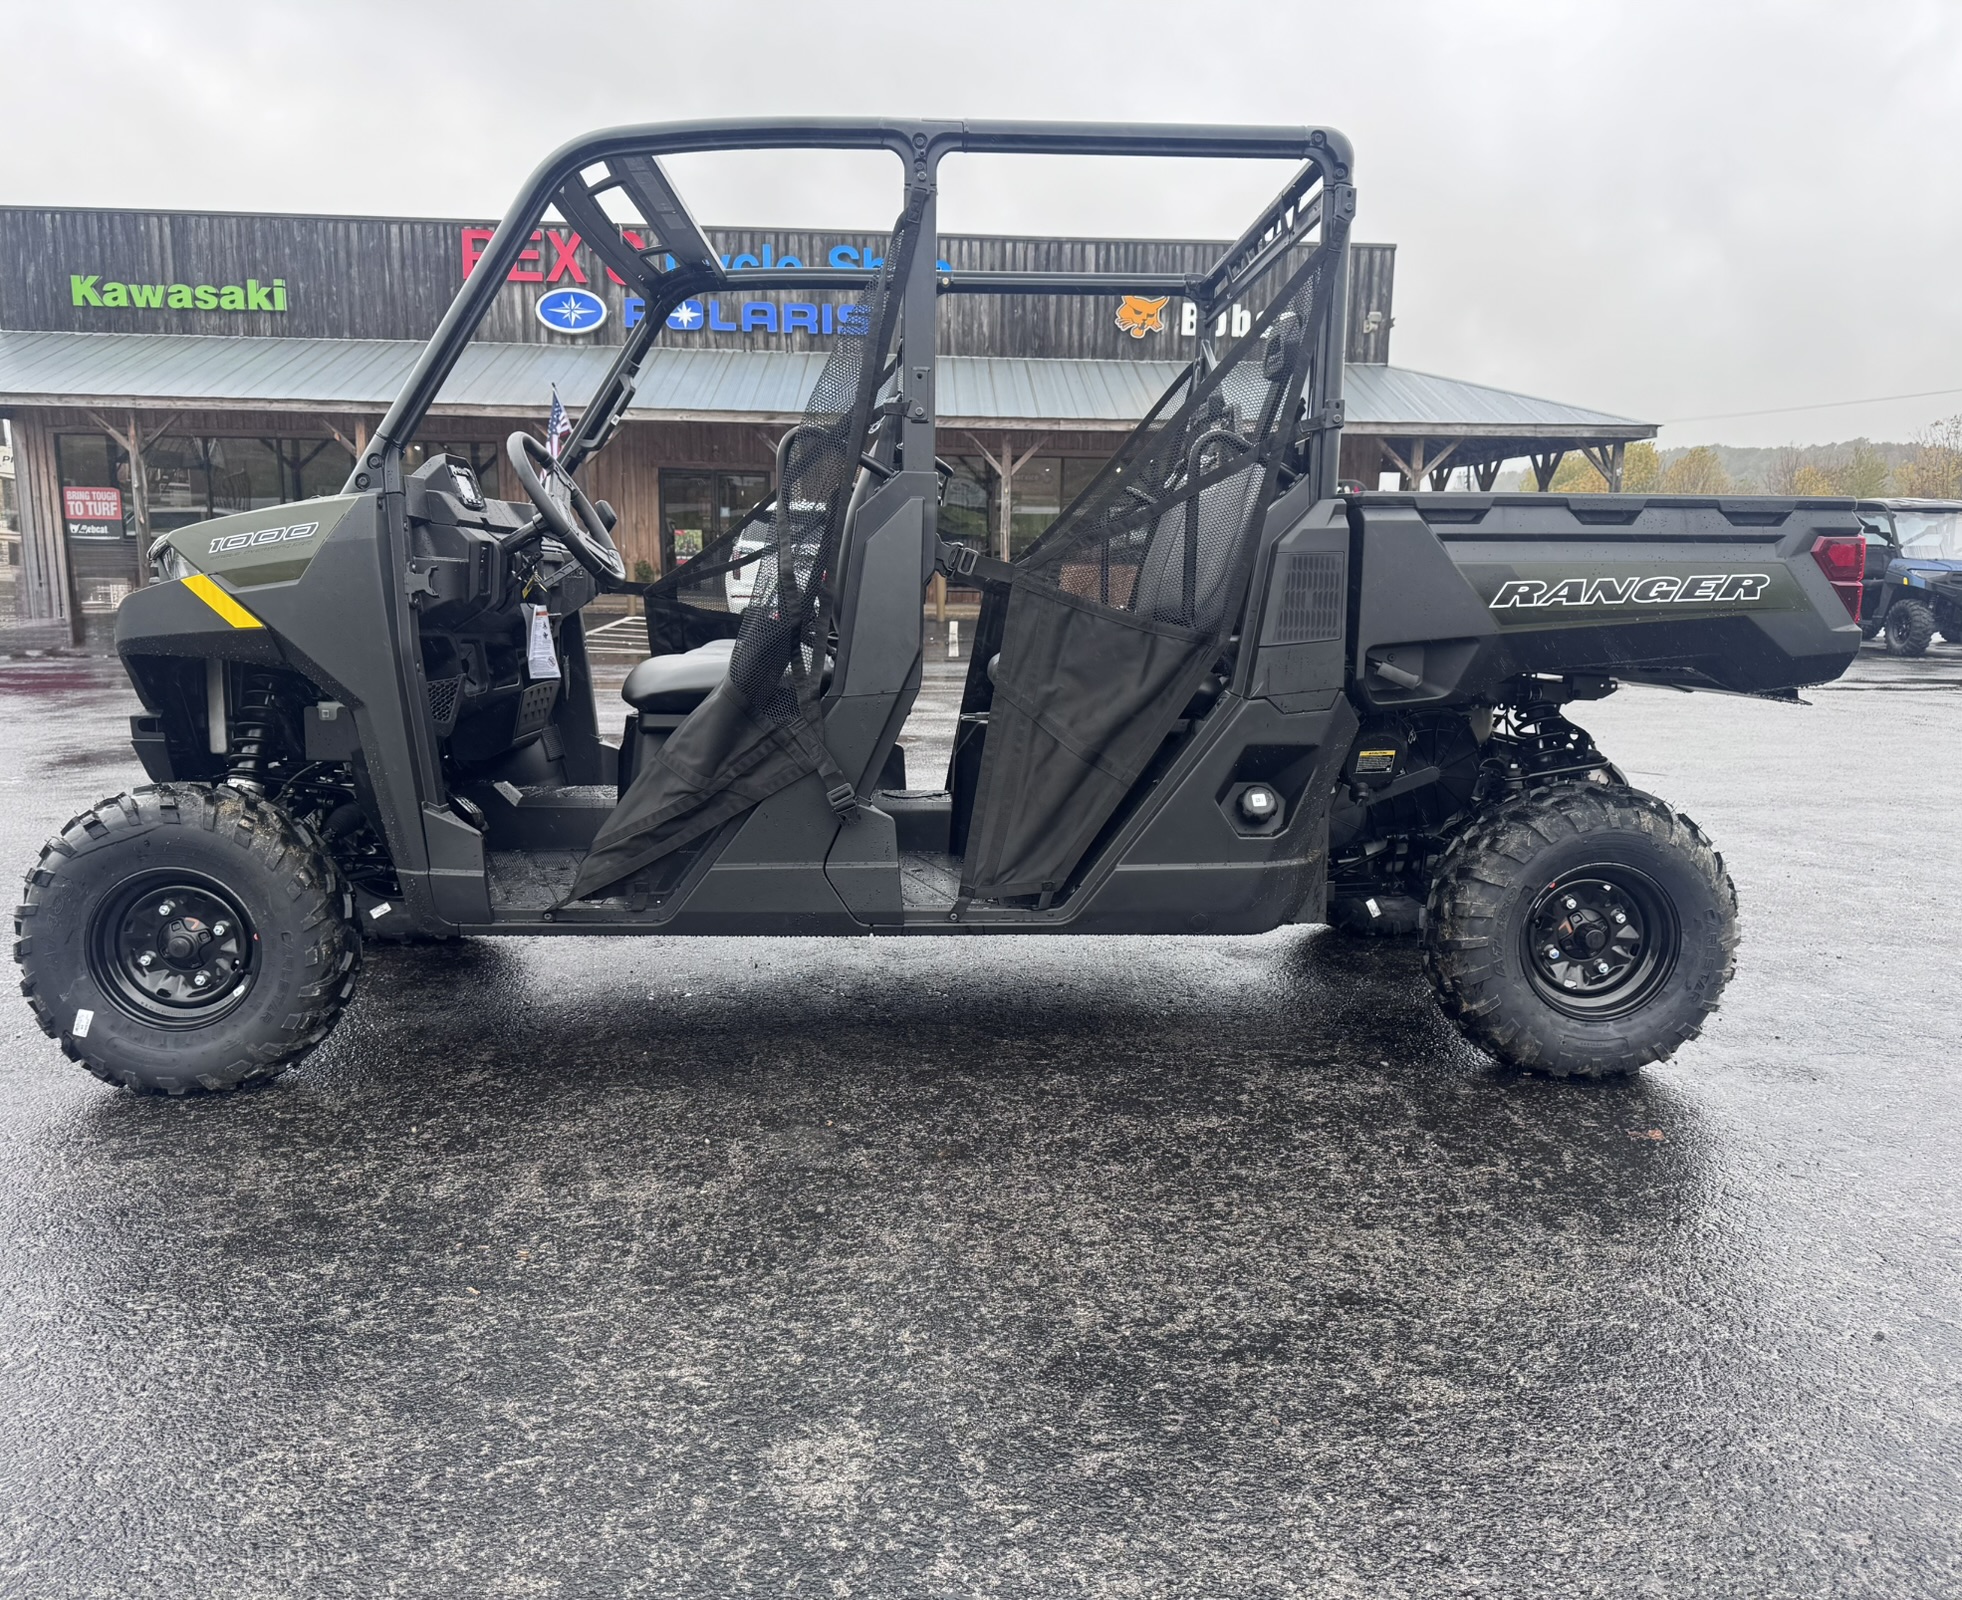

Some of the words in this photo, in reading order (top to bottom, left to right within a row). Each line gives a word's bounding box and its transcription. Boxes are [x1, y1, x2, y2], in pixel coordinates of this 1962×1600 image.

[461, 229, 646, 285] REX
[828, 244, 952, 272] Sh
[70, 274, 287, 311] Kawasaki
[624, 297, 870, 336] POLARIS
[66, 490, 91, 501] BRING
[91, 491, 118, 501] TOUGH
[67, 501, 84, 516] TO
[85, 501, 118, 517] TURF
[208, 521, 319, 554] 1000
[1489, 574, 1770, 608] RANGER
